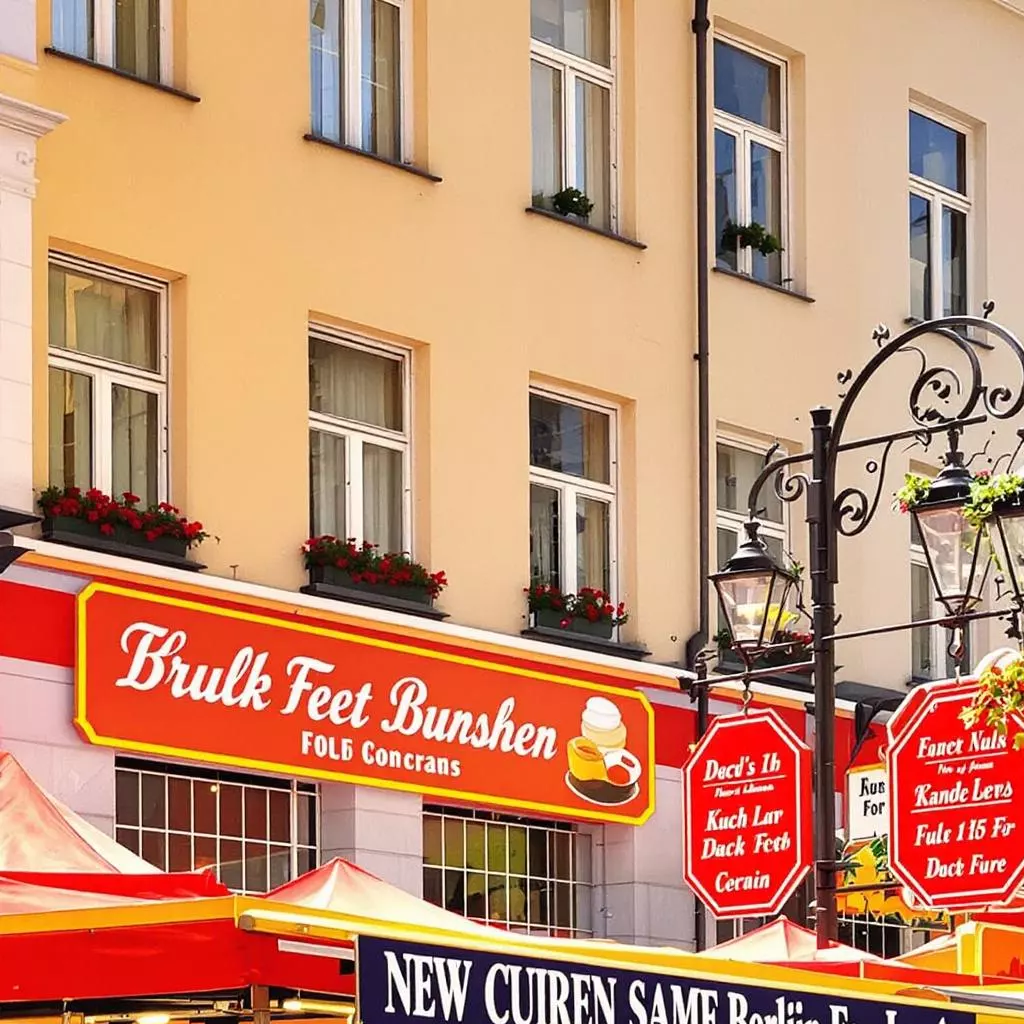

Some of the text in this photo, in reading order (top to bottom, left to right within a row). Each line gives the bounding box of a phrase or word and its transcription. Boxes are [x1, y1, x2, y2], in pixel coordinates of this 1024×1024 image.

[280, 656, 373, 729] Feet
[380, 677, 557, 760] Bunshen
[361, 740, 461, 777] Concrans
[384, 951, 472, 1022] NEW
